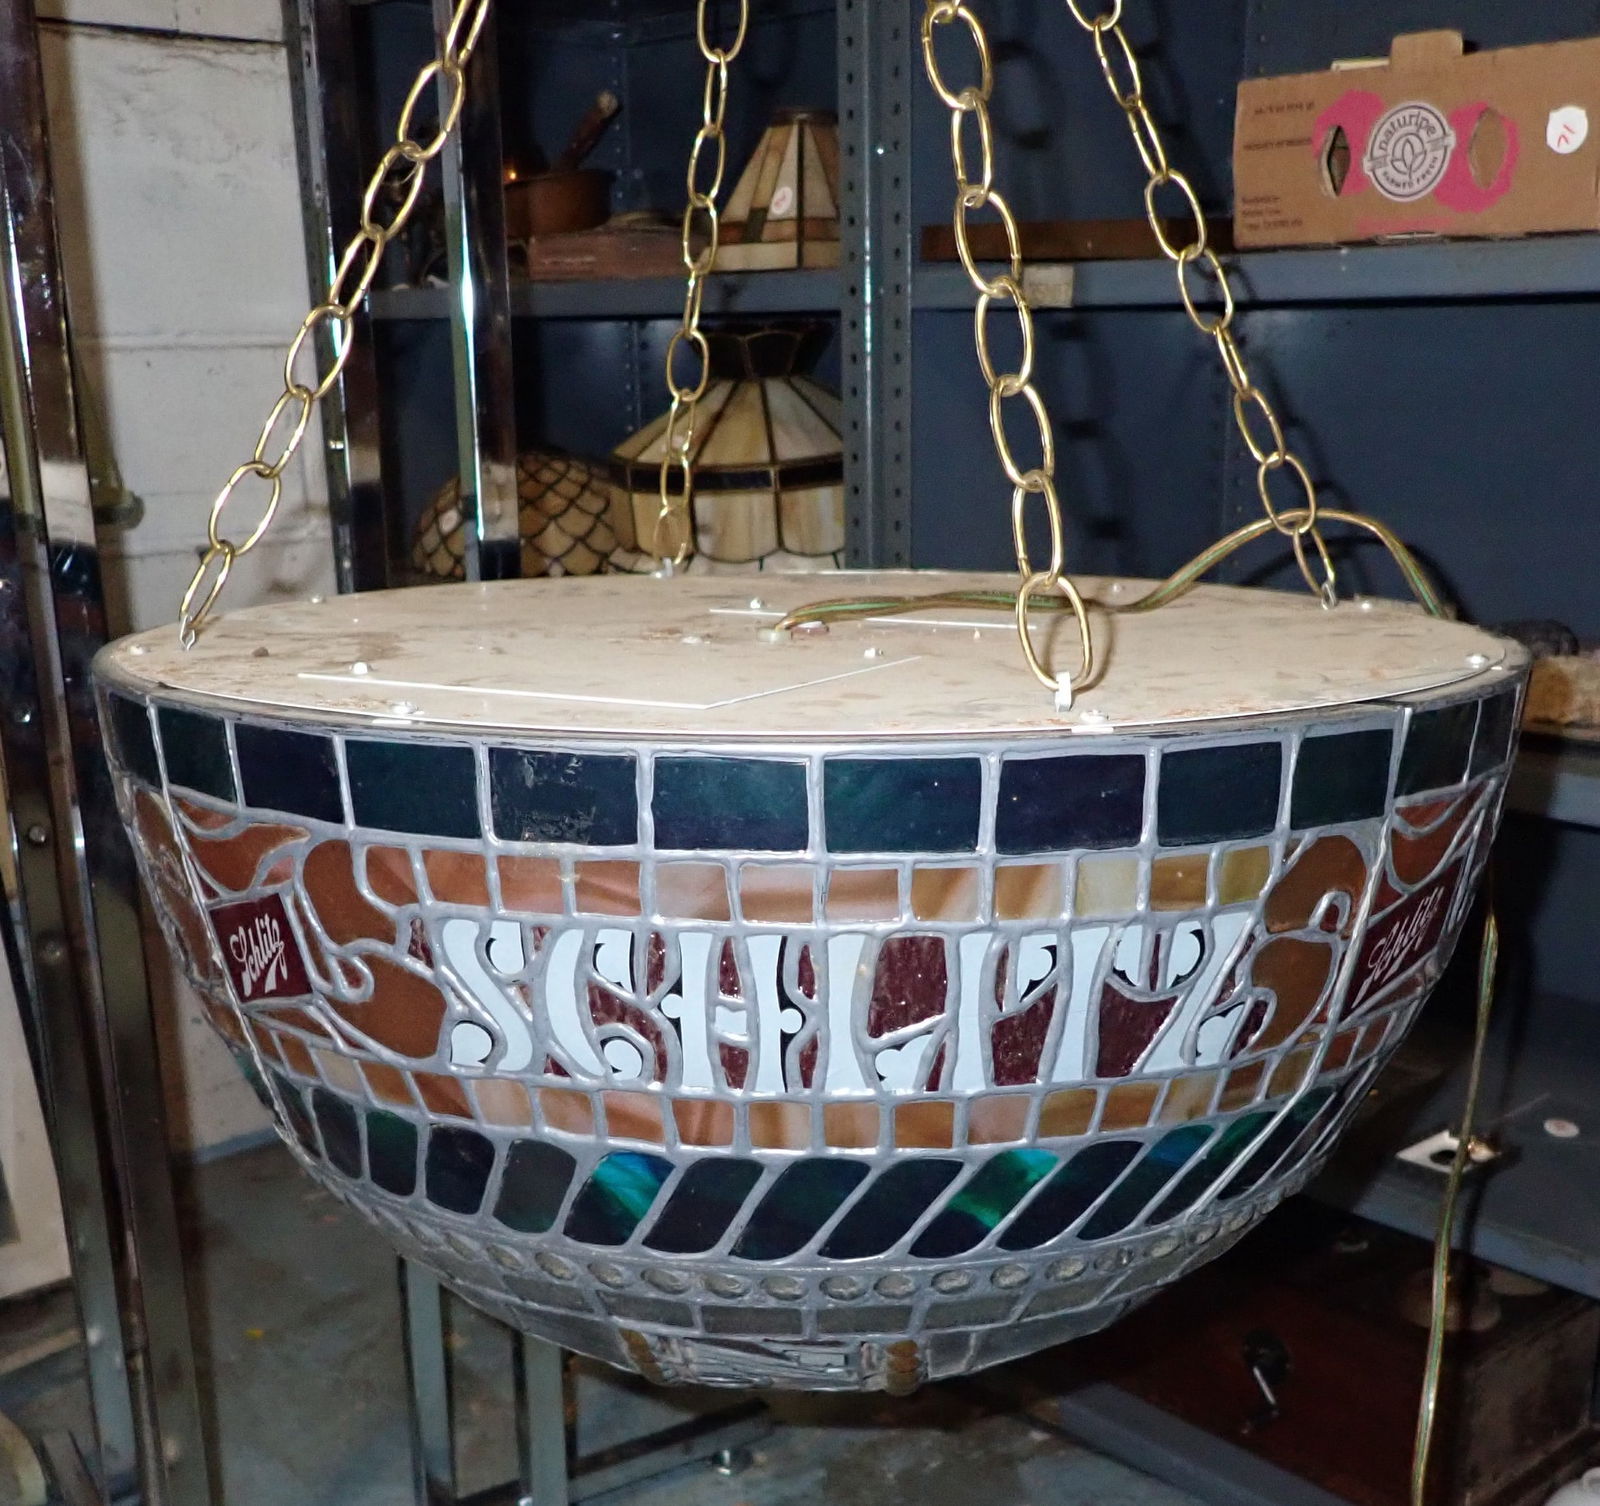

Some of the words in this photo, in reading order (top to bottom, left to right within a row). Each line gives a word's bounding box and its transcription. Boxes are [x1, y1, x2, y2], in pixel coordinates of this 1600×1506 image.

[1379, 111, 1437, 151] naturipe
[229, 912, 288, 998] Schlitz
[1351, 886, 1445, 1009] Schlitz
[441, 910, 1258, 1094] SCHLITZ
